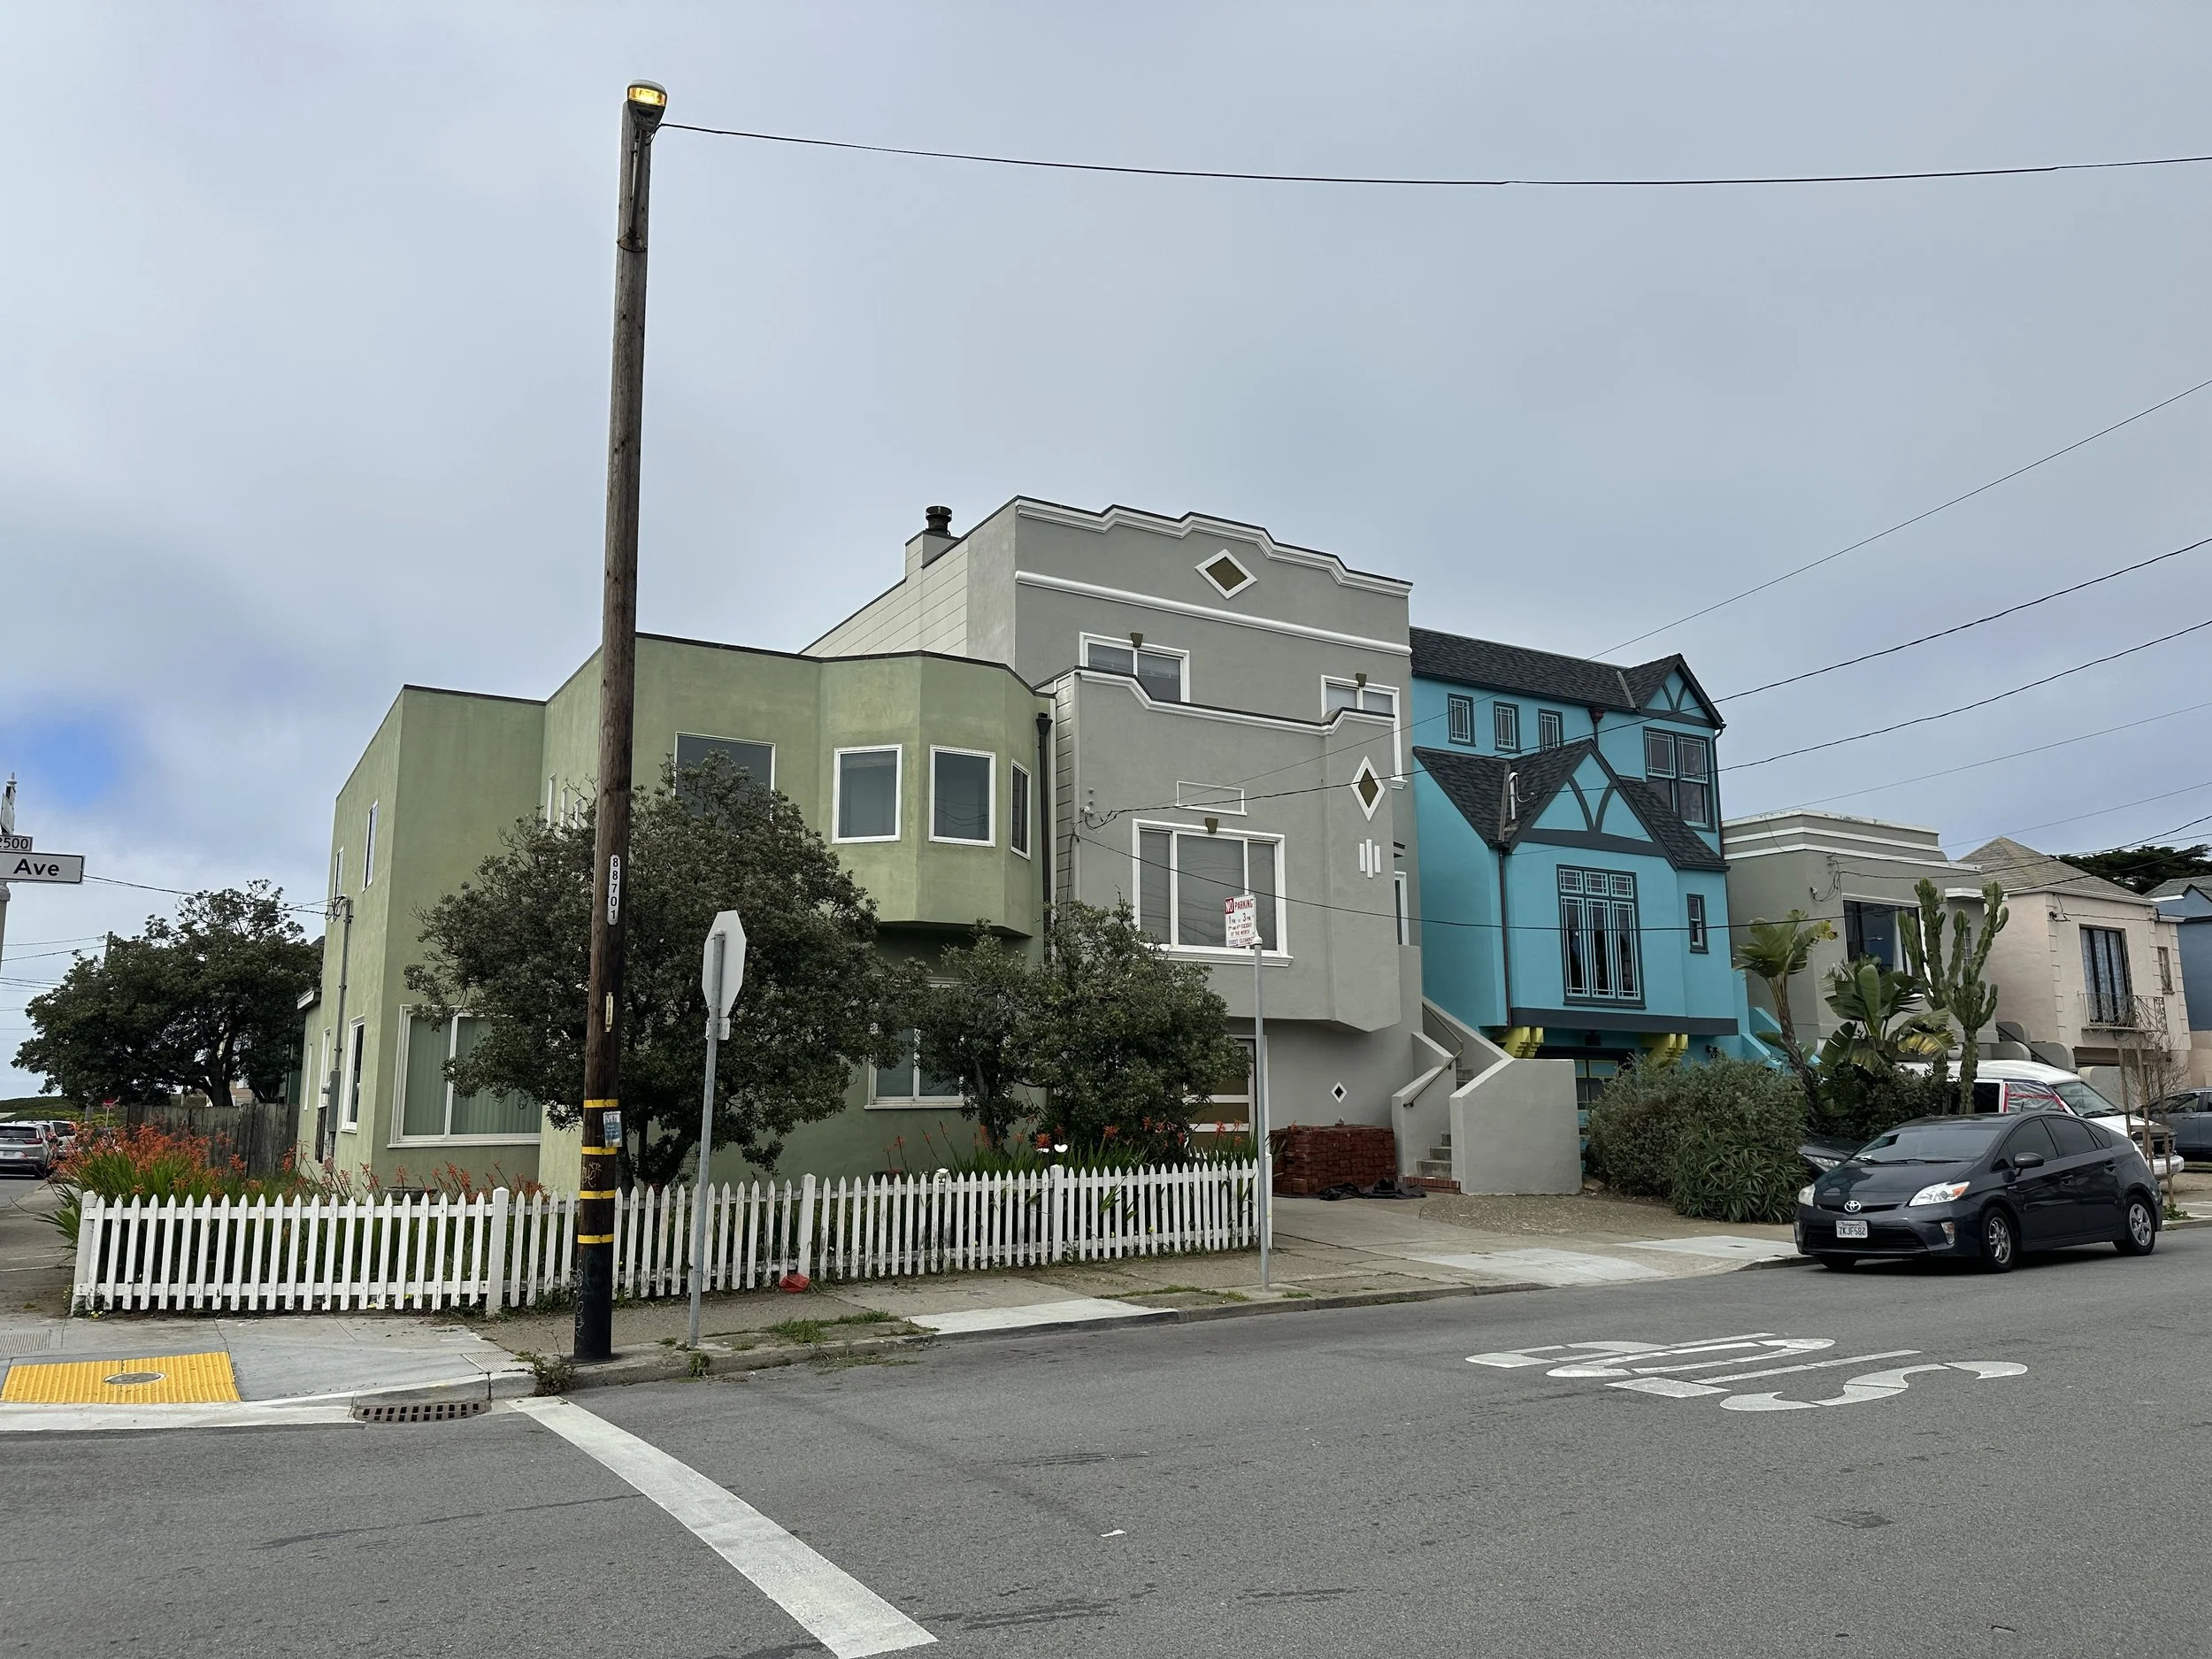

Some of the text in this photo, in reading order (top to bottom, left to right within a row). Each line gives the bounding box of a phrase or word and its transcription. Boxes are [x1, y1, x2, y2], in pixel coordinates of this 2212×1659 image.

[13, 858, 59, 876] Ave
[1225, 899, 1254, 912] NO PARKING
